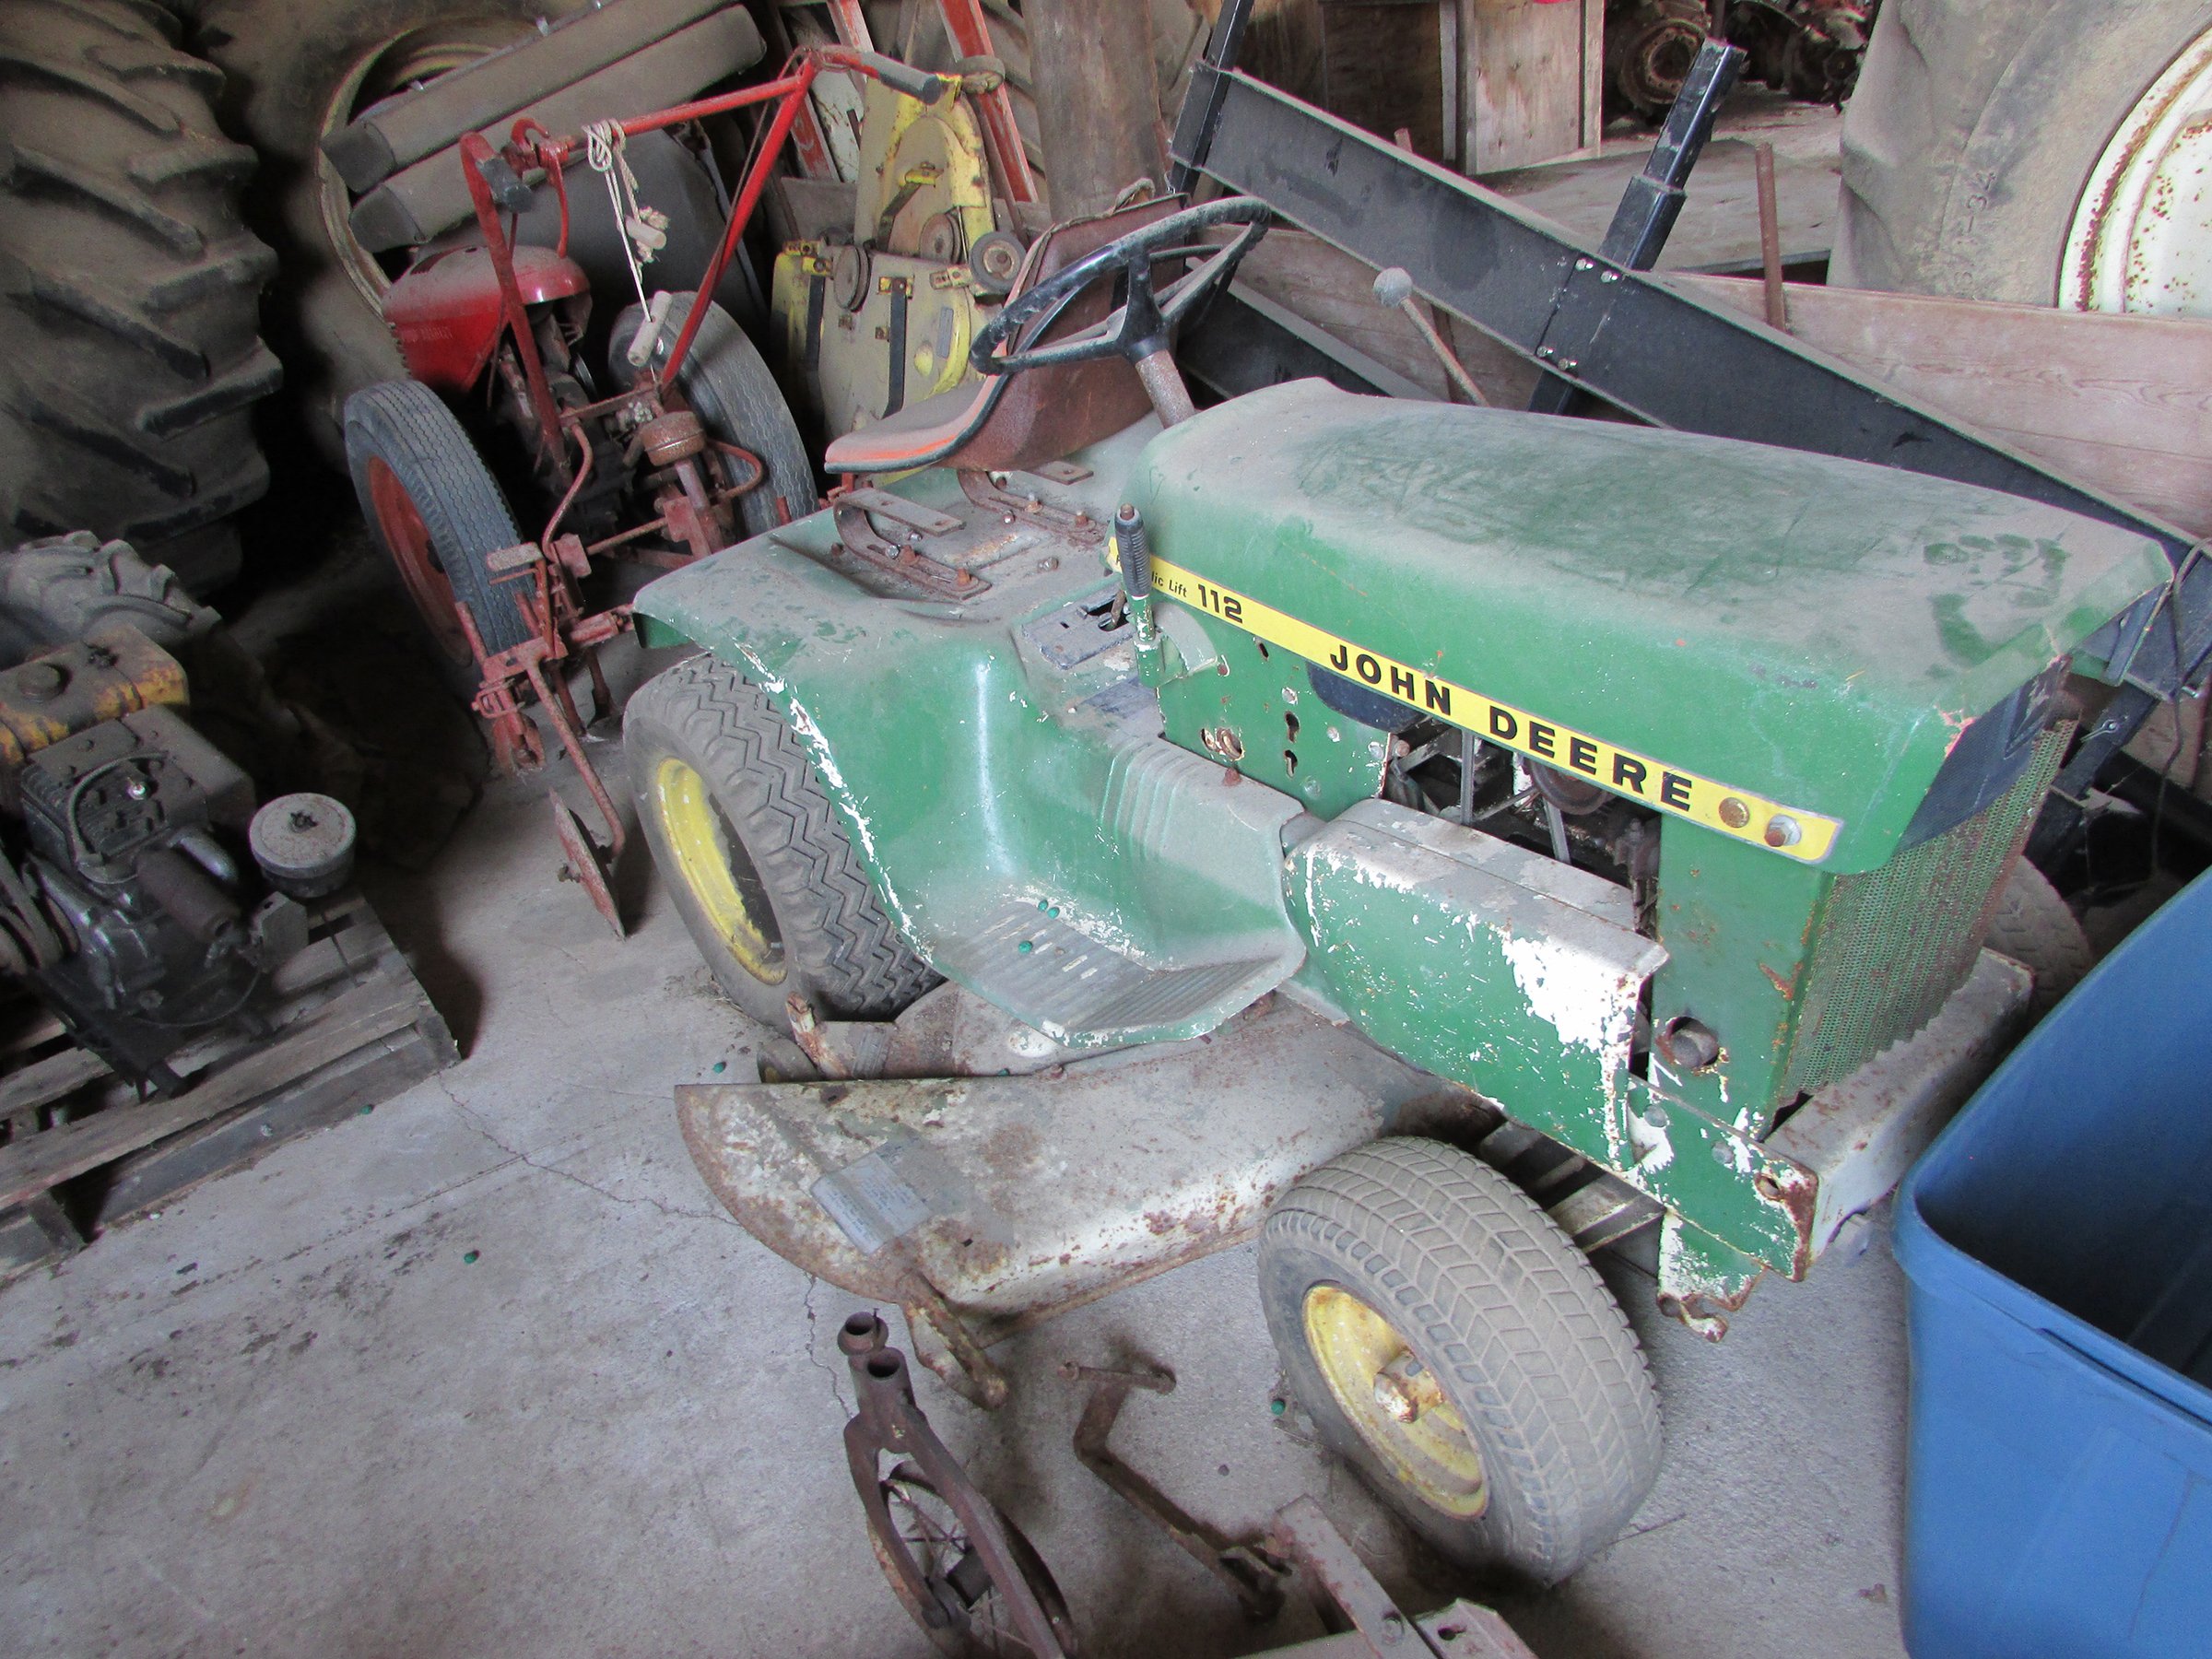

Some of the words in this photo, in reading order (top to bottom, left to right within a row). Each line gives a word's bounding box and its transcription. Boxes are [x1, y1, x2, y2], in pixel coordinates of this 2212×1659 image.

[1169, 580, 1188, 598] Lift
[1198, 583, 1243, 625] 112
[1330, 644, 1452, 717] JOHN
[1489, 705, 1692, 812] DEERE
